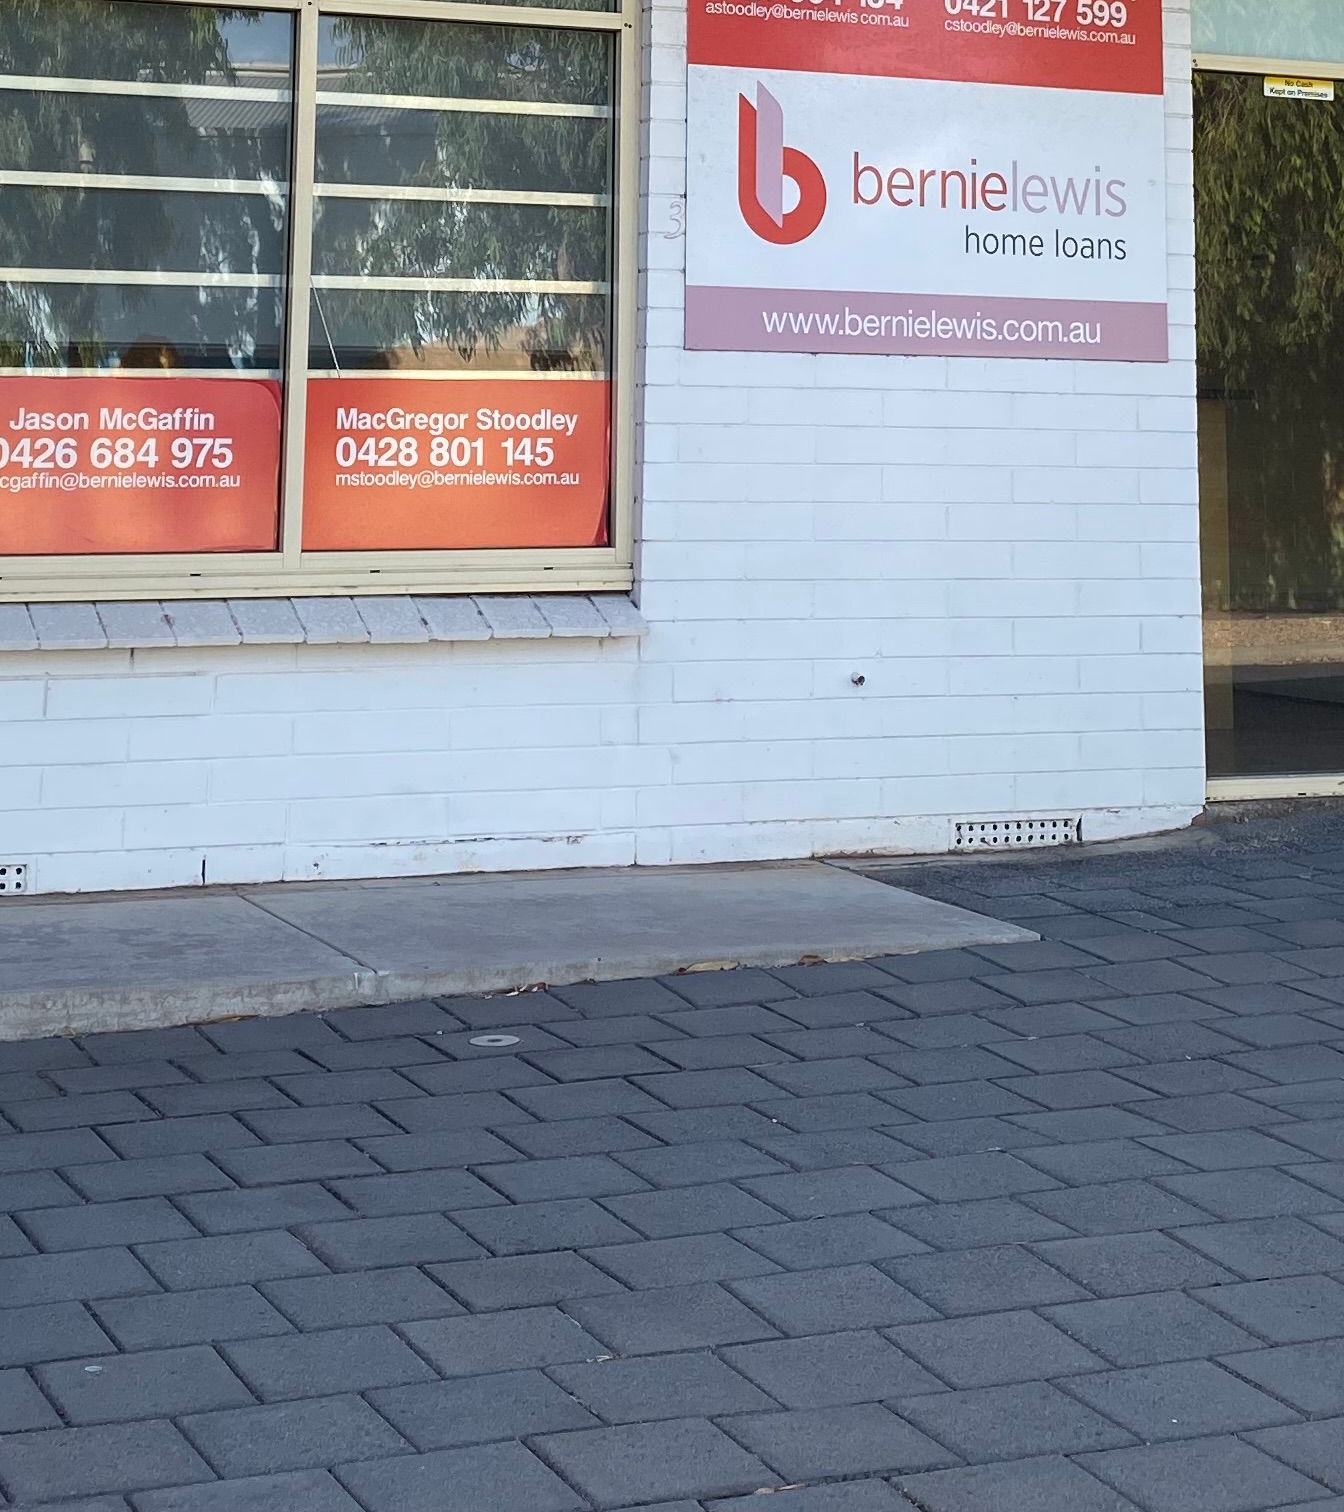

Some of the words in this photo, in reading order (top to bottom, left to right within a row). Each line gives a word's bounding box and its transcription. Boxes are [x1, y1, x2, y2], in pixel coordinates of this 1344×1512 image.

[944, 18, 1136, 45] cstoodley@bernielewis.com.au
[1284, 79, 1295, 87] No
[1295, 79, 1314, 88] Cash
[852, 150, 1128, 218] bernielewis
[965, 224, 1044, 257] home
[1055, 229, 1127, 261] loans
[761, 306, 1102, 345] www.bernielewis.com.au
[9, 407, 89, 431] Jason
[99, 407, 215, 431] McGaffin
[336, 407, 469, 436] MacGregor
[476, 408, 578, 436] Stoodley
[90, 437, 159, 469] 684
[171, 437, 233, 469] 975
[335, 436, 419, 468] 0428
[429, 436, 484, 467] 801
[501, 437, 555, 467] 145
[335, 470, 580, 490] mstoodley@bernielewis.com.au
